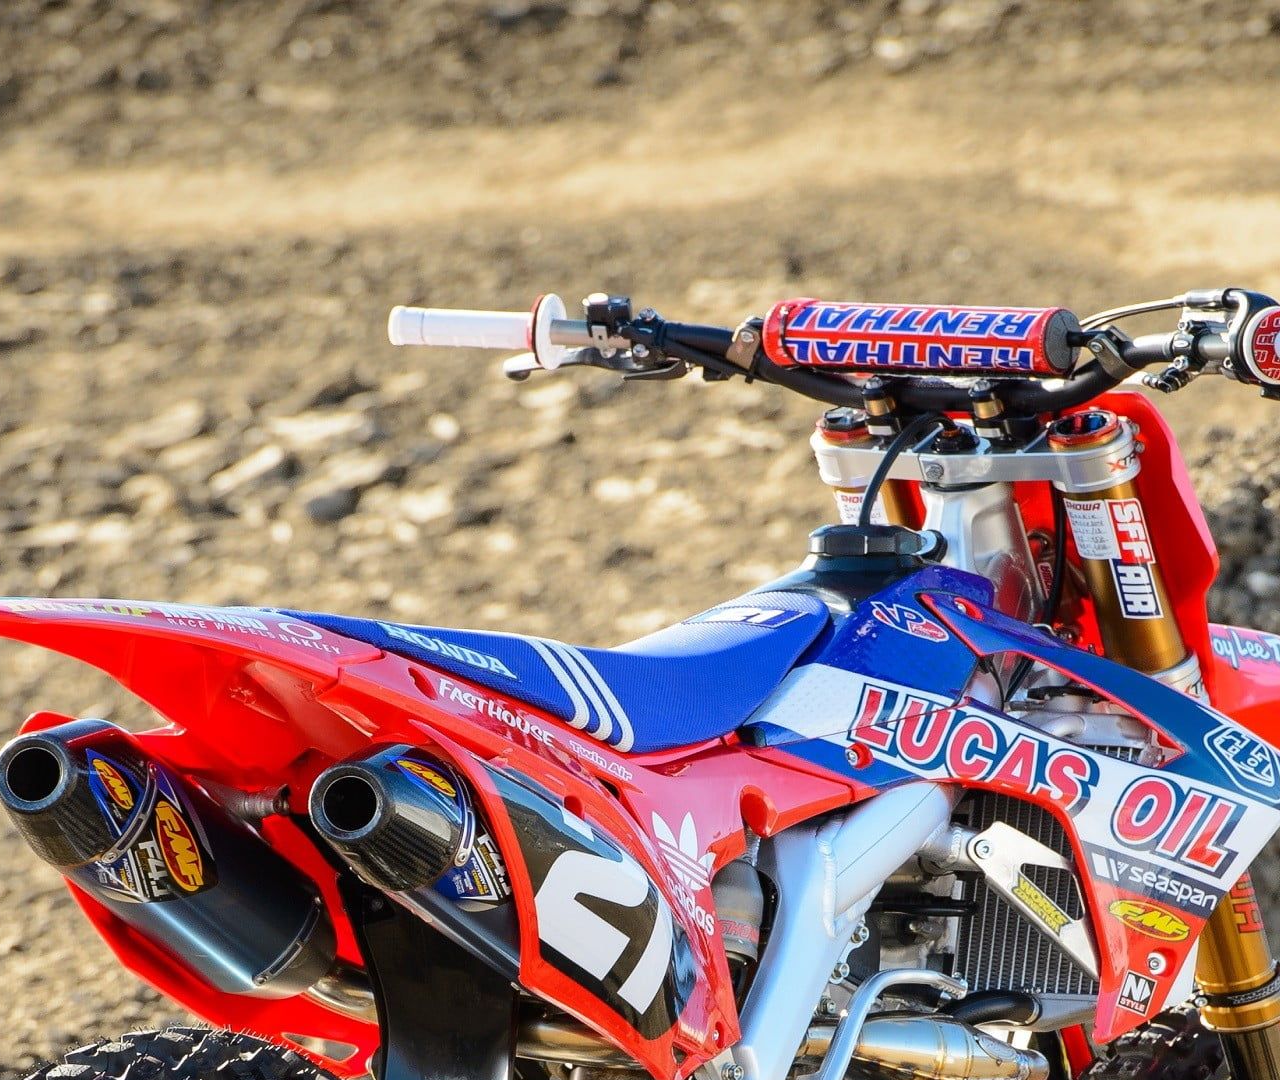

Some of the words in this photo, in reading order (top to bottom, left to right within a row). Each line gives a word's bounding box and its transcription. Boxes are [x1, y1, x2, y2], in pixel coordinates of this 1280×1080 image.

[784, 337, 1034, 369] RENTHAL
[1066, 502, 1101, 511] SHOWA
[1111, 502, 1152, 563] SFF
[1117, 565, 1158, 617] AIR
[166, 617, 207, 630] RACE
[214, 622, 276, 640] WHEELS
[279, 633, 342, 655] OAKLEY
[376, 621, 518, 680] HONDA
[1232, 629, 1271, 660] Lee
[438, 677, 556, 748] FASTHOUSE
[93, 758, 134, 808] FMF
[397, 760, 457, 797] FMF
[568, 740, 608, 771] Twin
[607, 762, 634, 782] Air
[848, 683, 1100, 815] LUCAS
[1111, 773, 1248, 888] OIL
[139, 840, 170, 898] F4.1
[155, 803, 205, 887] FMF
[667, 871, 715, 937] adidas
[1019, 876, 1070, 926] WORKS
[1128, 865, 1219, 911] seaspan
[1109, 900, 1191, 937] FMF
[1119, 996, 1147, 1012] STYLE
